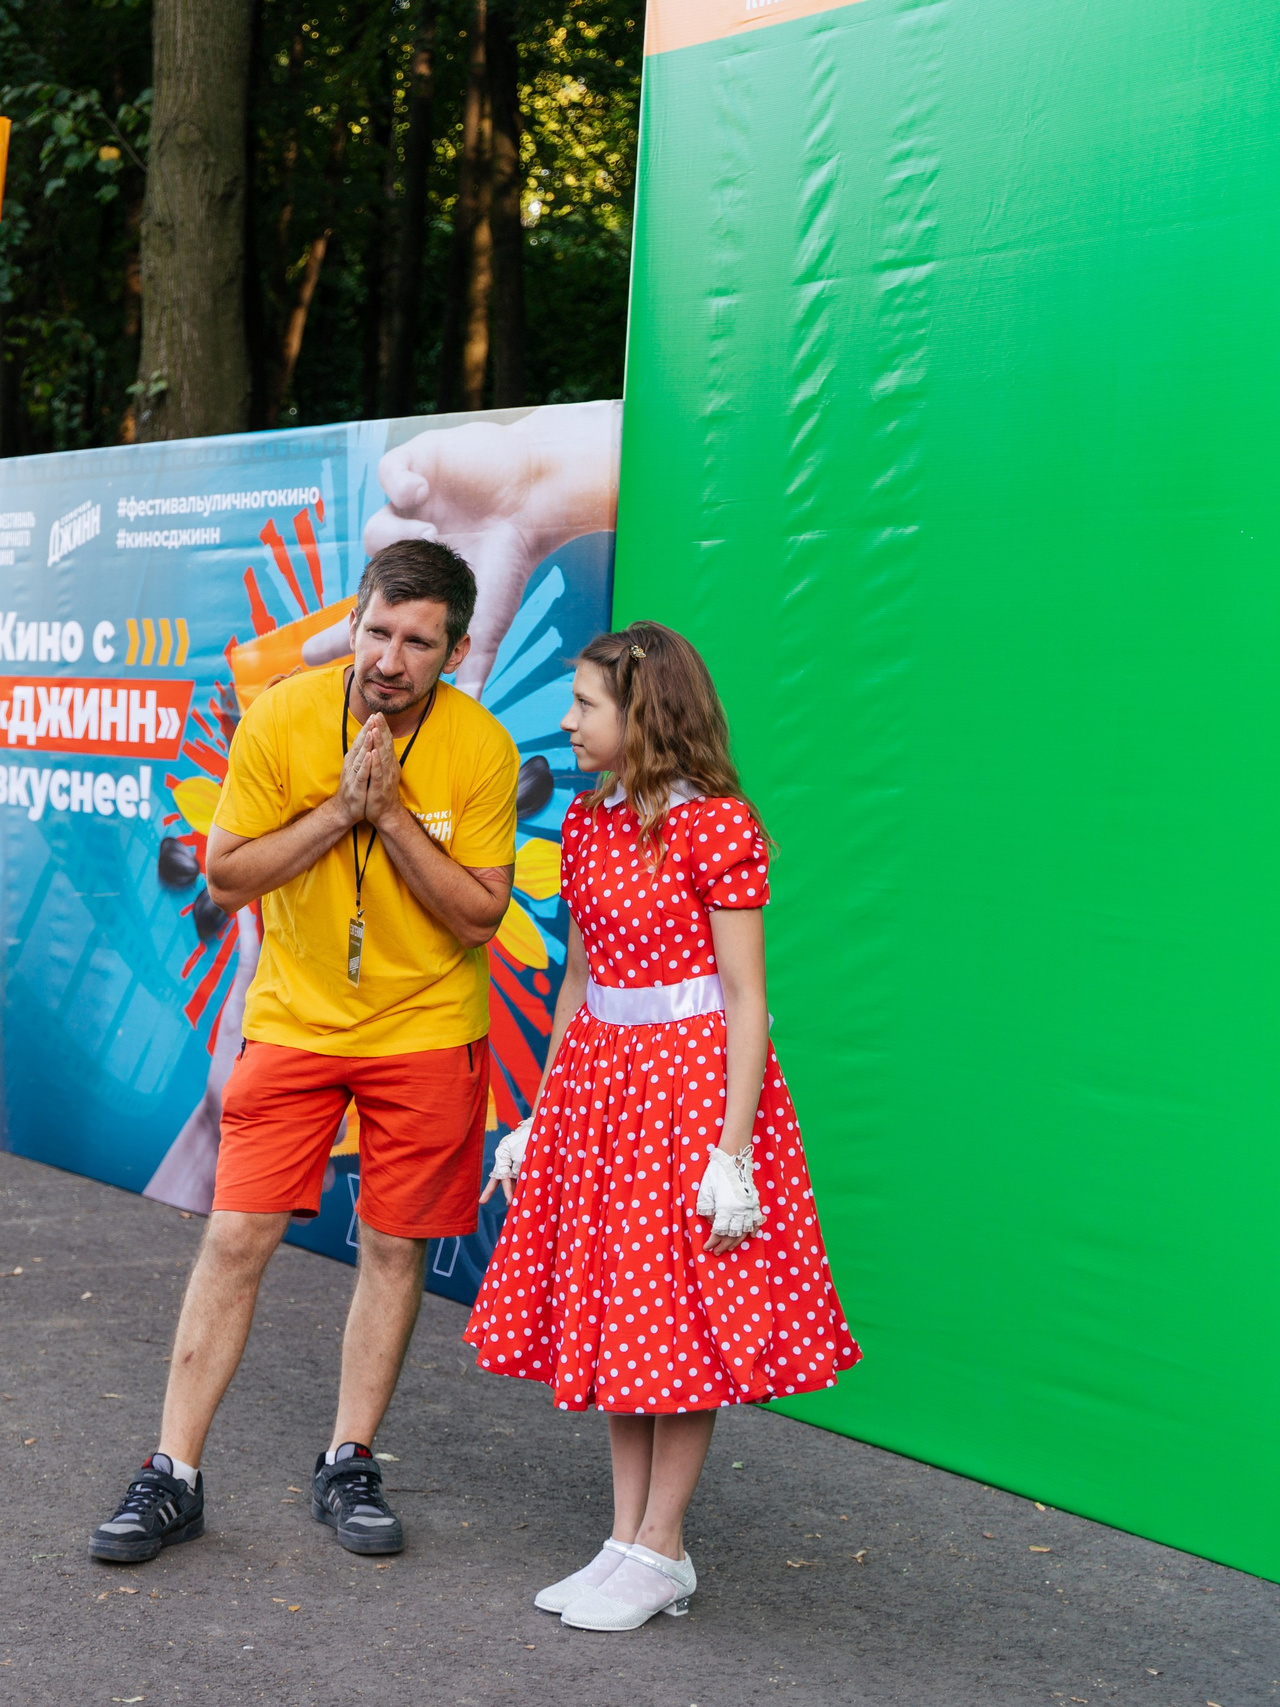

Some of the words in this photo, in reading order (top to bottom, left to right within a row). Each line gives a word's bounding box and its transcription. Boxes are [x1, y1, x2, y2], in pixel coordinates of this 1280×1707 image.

[116, 486, 321, 522] #фестивальуличногокино
[116, 527, 221, 549] #киносджинн
[92, 620, 116, 664] с
